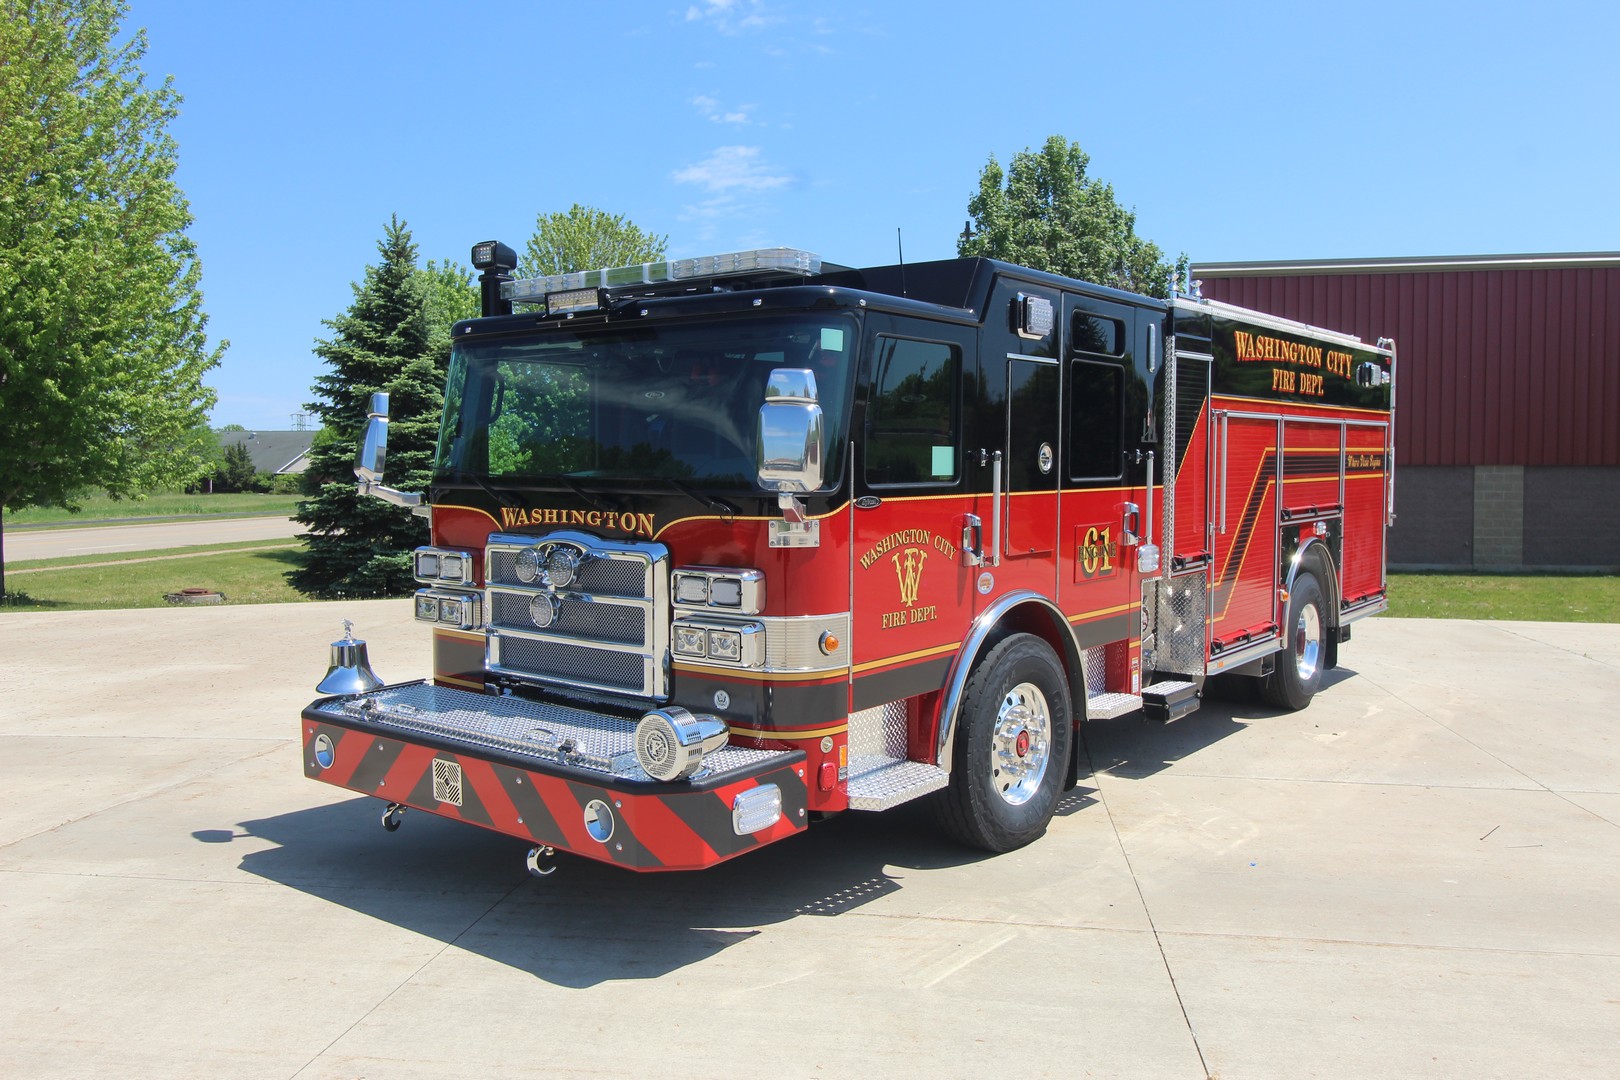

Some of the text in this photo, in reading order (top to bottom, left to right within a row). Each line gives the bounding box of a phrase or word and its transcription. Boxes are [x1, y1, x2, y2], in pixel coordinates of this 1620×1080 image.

[1234, 330, 1353, 379] WASHINGTON CITY
[1272, 368, 1324, 396] FIRE DEPT.
[500, 507, 655, 537] WASHINGTON
[860, 529, 957, 570] WASHINGTON CITY
[1077, 541, 1117, 562] ENGINE
[1083, 526, 1112, 575] 61
[881, 606, 937, 629] FIRE DEPT.
